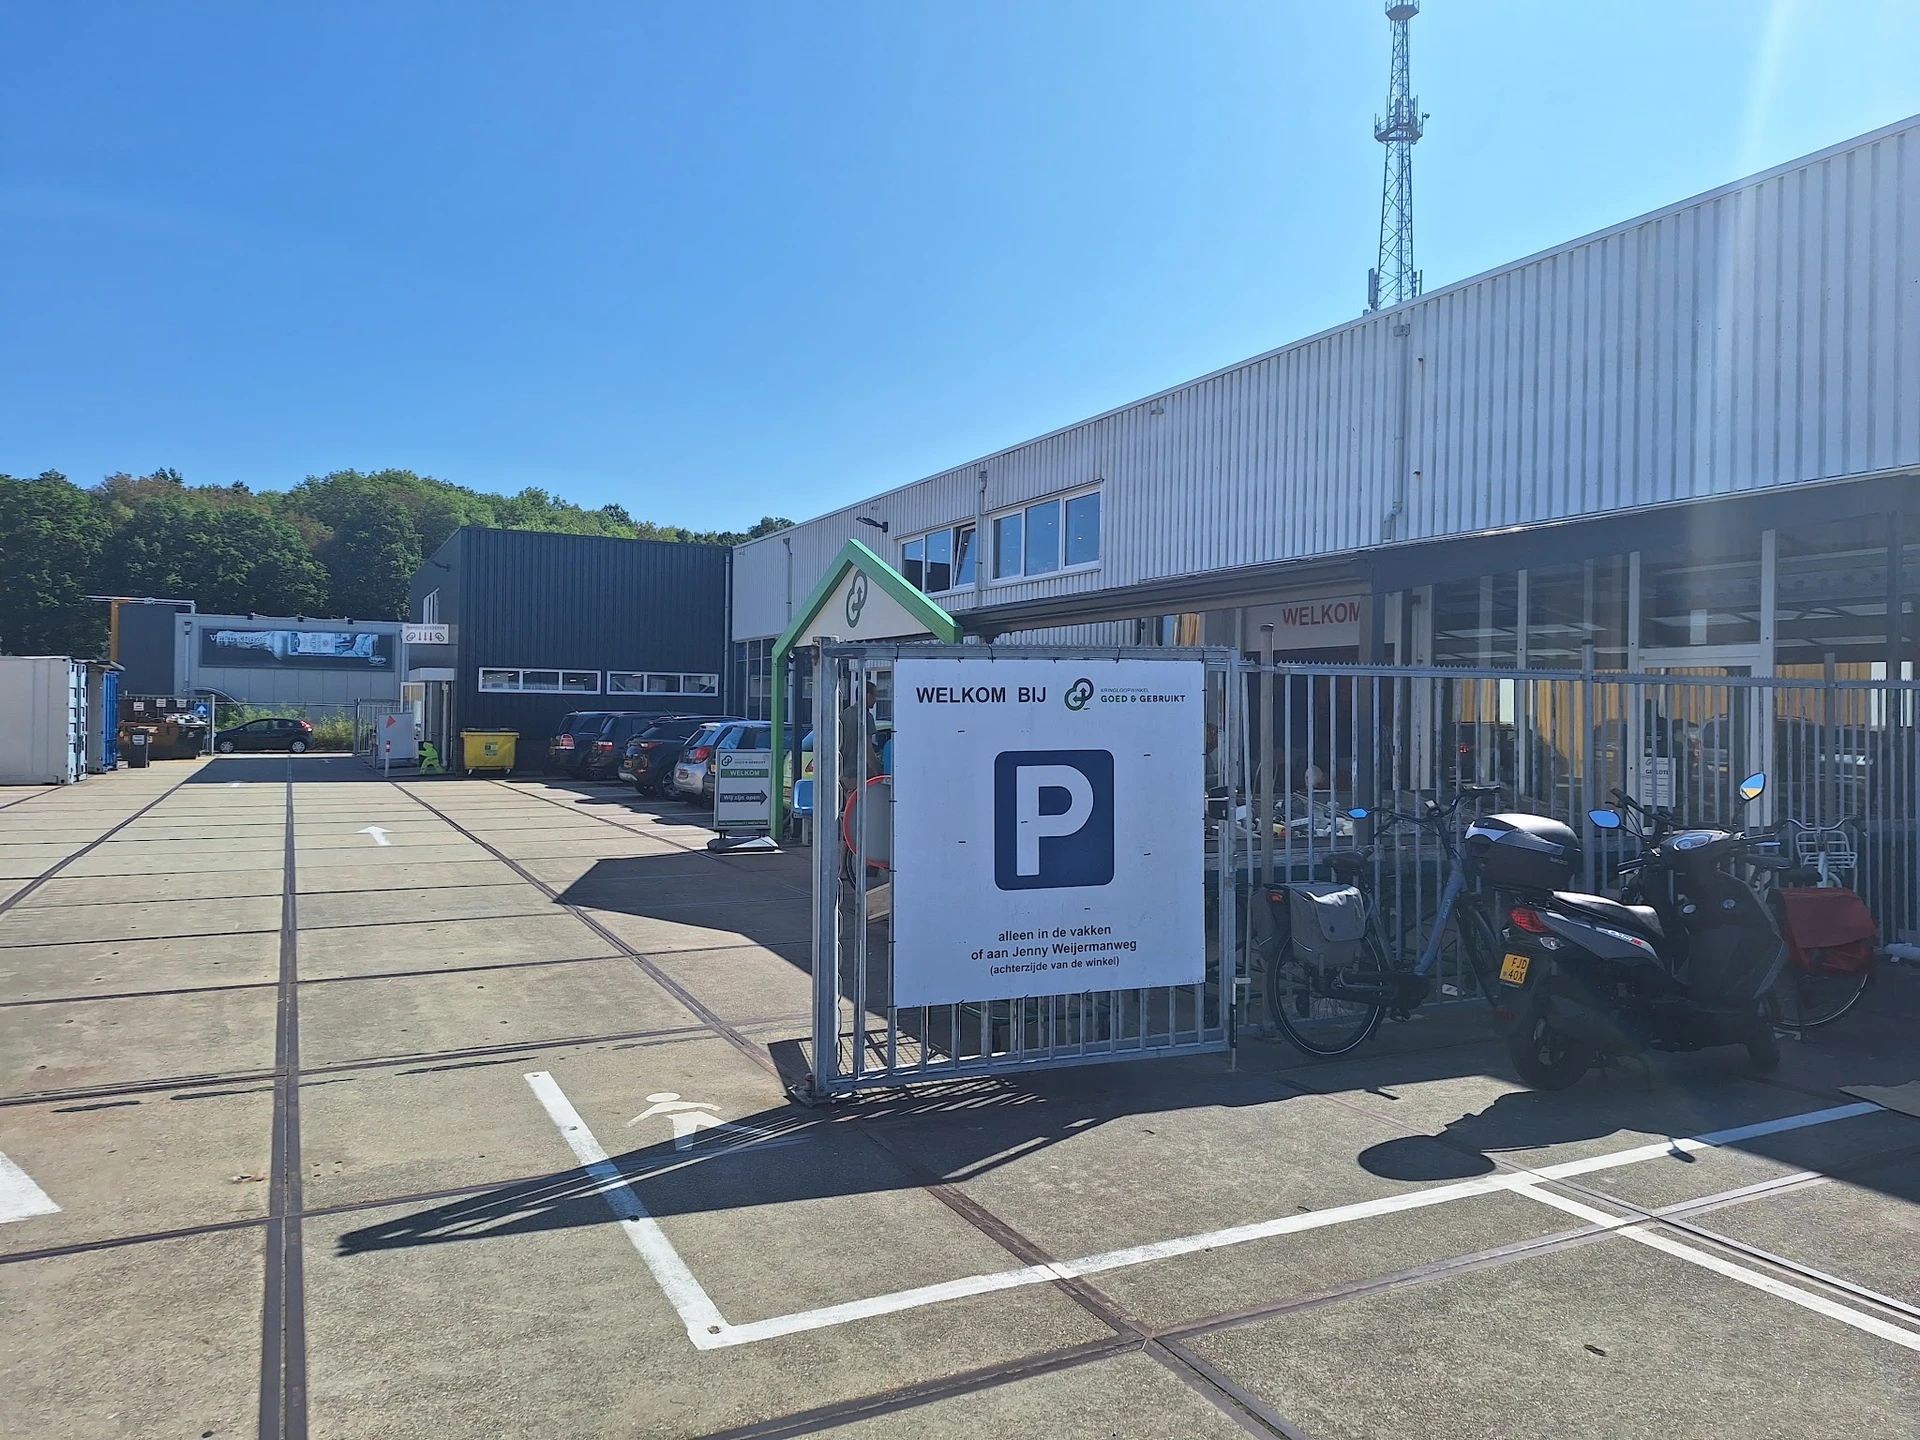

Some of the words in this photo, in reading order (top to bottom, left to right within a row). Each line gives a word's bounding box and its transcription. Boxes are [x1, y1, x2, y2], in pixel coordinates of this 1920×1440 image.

[1282, 602, 1361, 626] WELKOM
[916, 687, 1006, 703] WELKOM
[1018, 687, 1046, 703] BIJ
[1101, 695, 1128, 703] GOED
[1131, 695, 1137, 703] &
[1139, 694, 1186, 703] GEBRUIKT
[1016, 764, 1094, 877] P
[998, 929, 1034, 942] alleen
[1038, 928, 1048, 939] in
[1052, 927, 1067, 938] de
[1070, 925, 1112, 937] vakken
[971, 948, 984, 960] of
[987, 949, 1009, 959] aan
[1012, 945, 1049, 958] Jenny
[1052, 940, 1137, 956] Weijermanweg
[990, 961, 1048, 976] (achterzijde
[1051, 961, 1068, 970] van
[1071, 959, 1083, 969] de
[1085, 956, 1120, 967] winkel)
[1511, 957, 1528, 969] FJD
[1508, 970, 1525, 981] 40X
